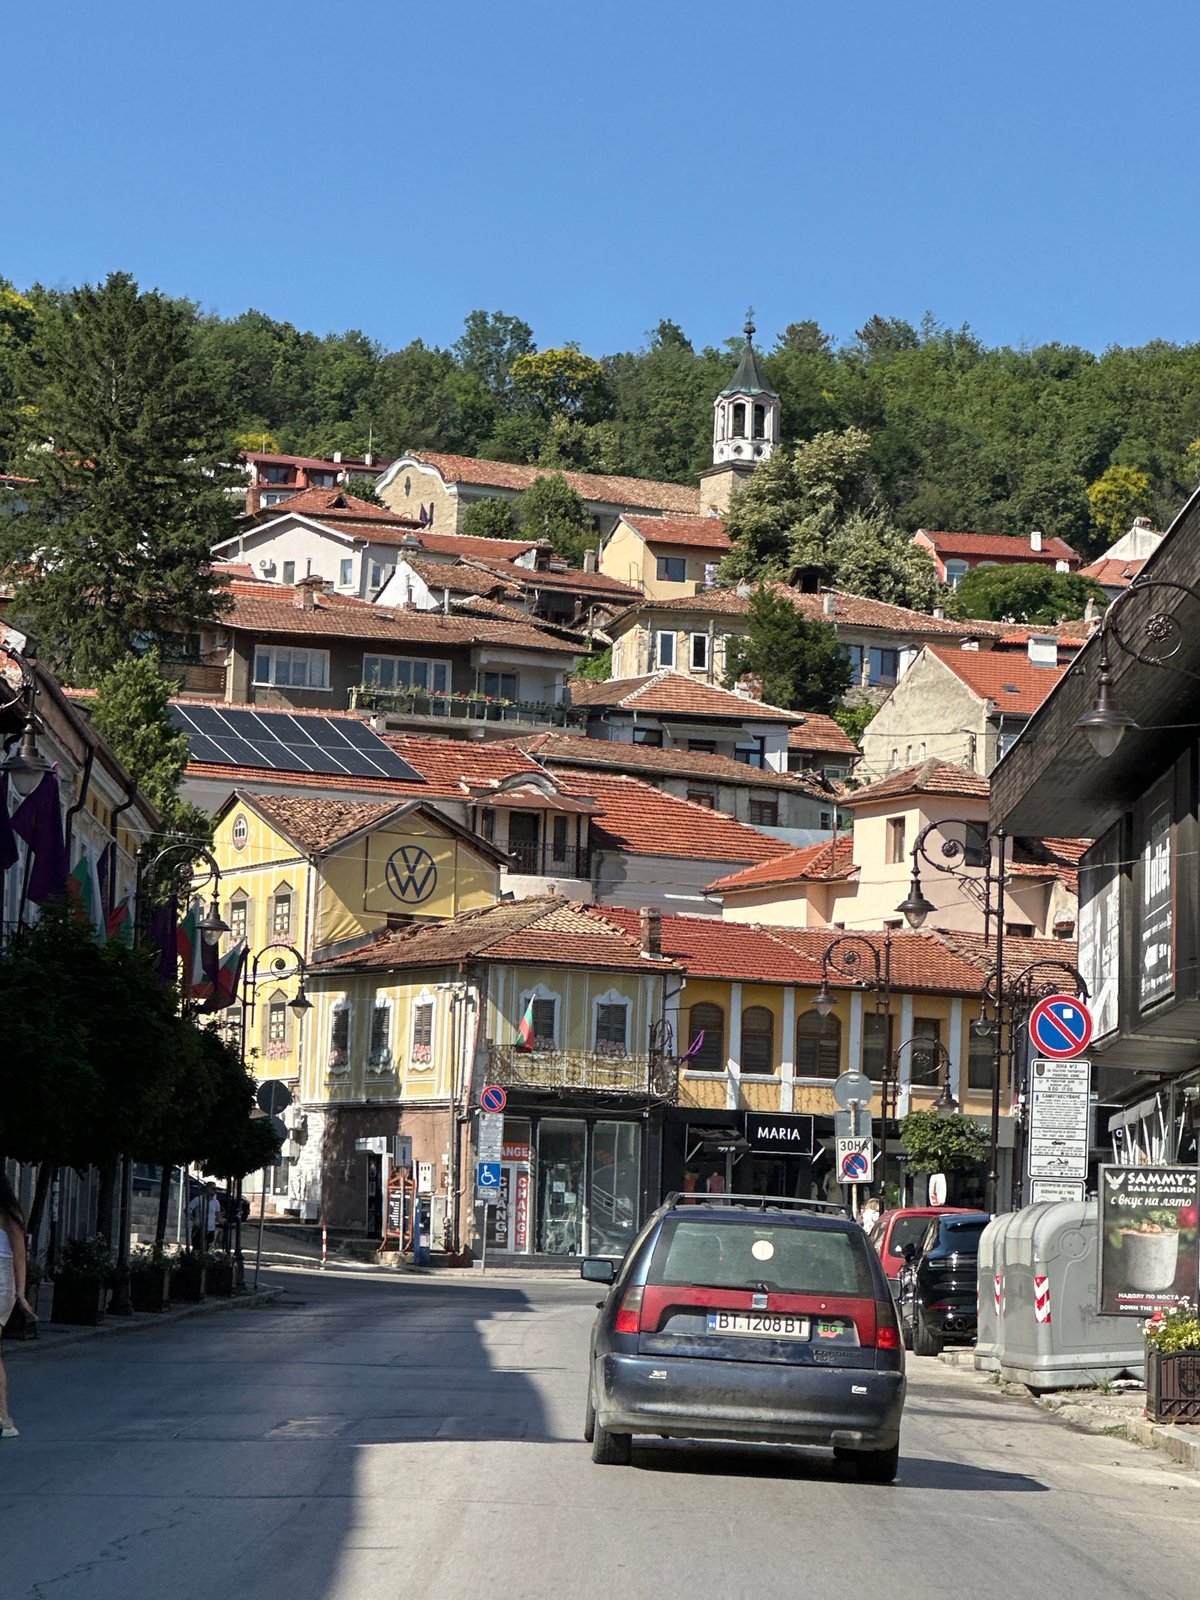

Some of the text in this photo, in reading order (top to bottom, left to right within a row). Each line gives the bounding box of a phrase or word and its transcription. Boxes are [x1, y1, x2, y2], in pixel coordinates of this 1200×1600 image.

[757, 1126, 801, 1141] MARIA
[1127, 1172, 1197, 1186] SAMMY'S
[1157, 1186, 1196, 1194] GARDEN
[1110, 1193, 1192, 1208] с вкус на лято
[495, 1176, 508, 1243] CHANGE
[516, 1177, 527, 1244] CHANGE
[1118, 1292, 1145, 1300] НАДОЛУ
[718, 1313, 806, 1335] BT 1208 BT
[822, 1324, 838, 1333] BG
